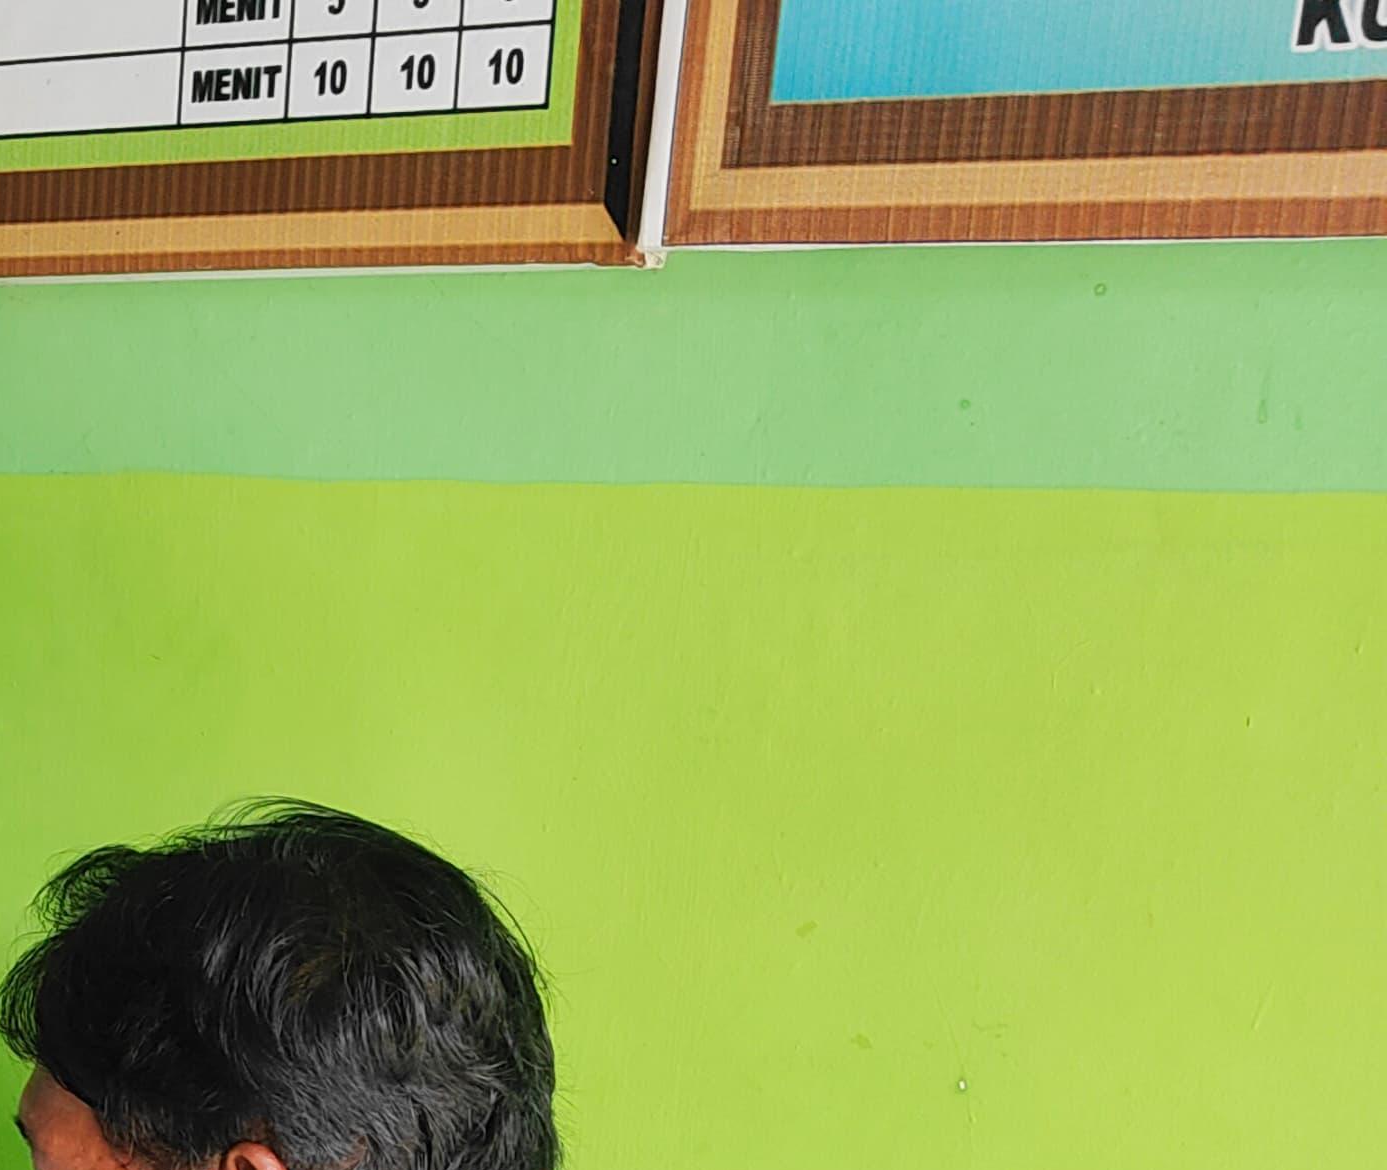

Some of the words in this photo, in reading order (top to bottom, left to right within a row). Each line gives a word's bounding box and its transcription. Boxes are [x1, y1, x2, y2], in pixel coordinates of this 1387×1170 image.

[192, 65, 283, 103] MENIT
[314, 60, 347, 95] 10
[401, 54, 435, 90] 10
[489, 48, 524, 85] 10
